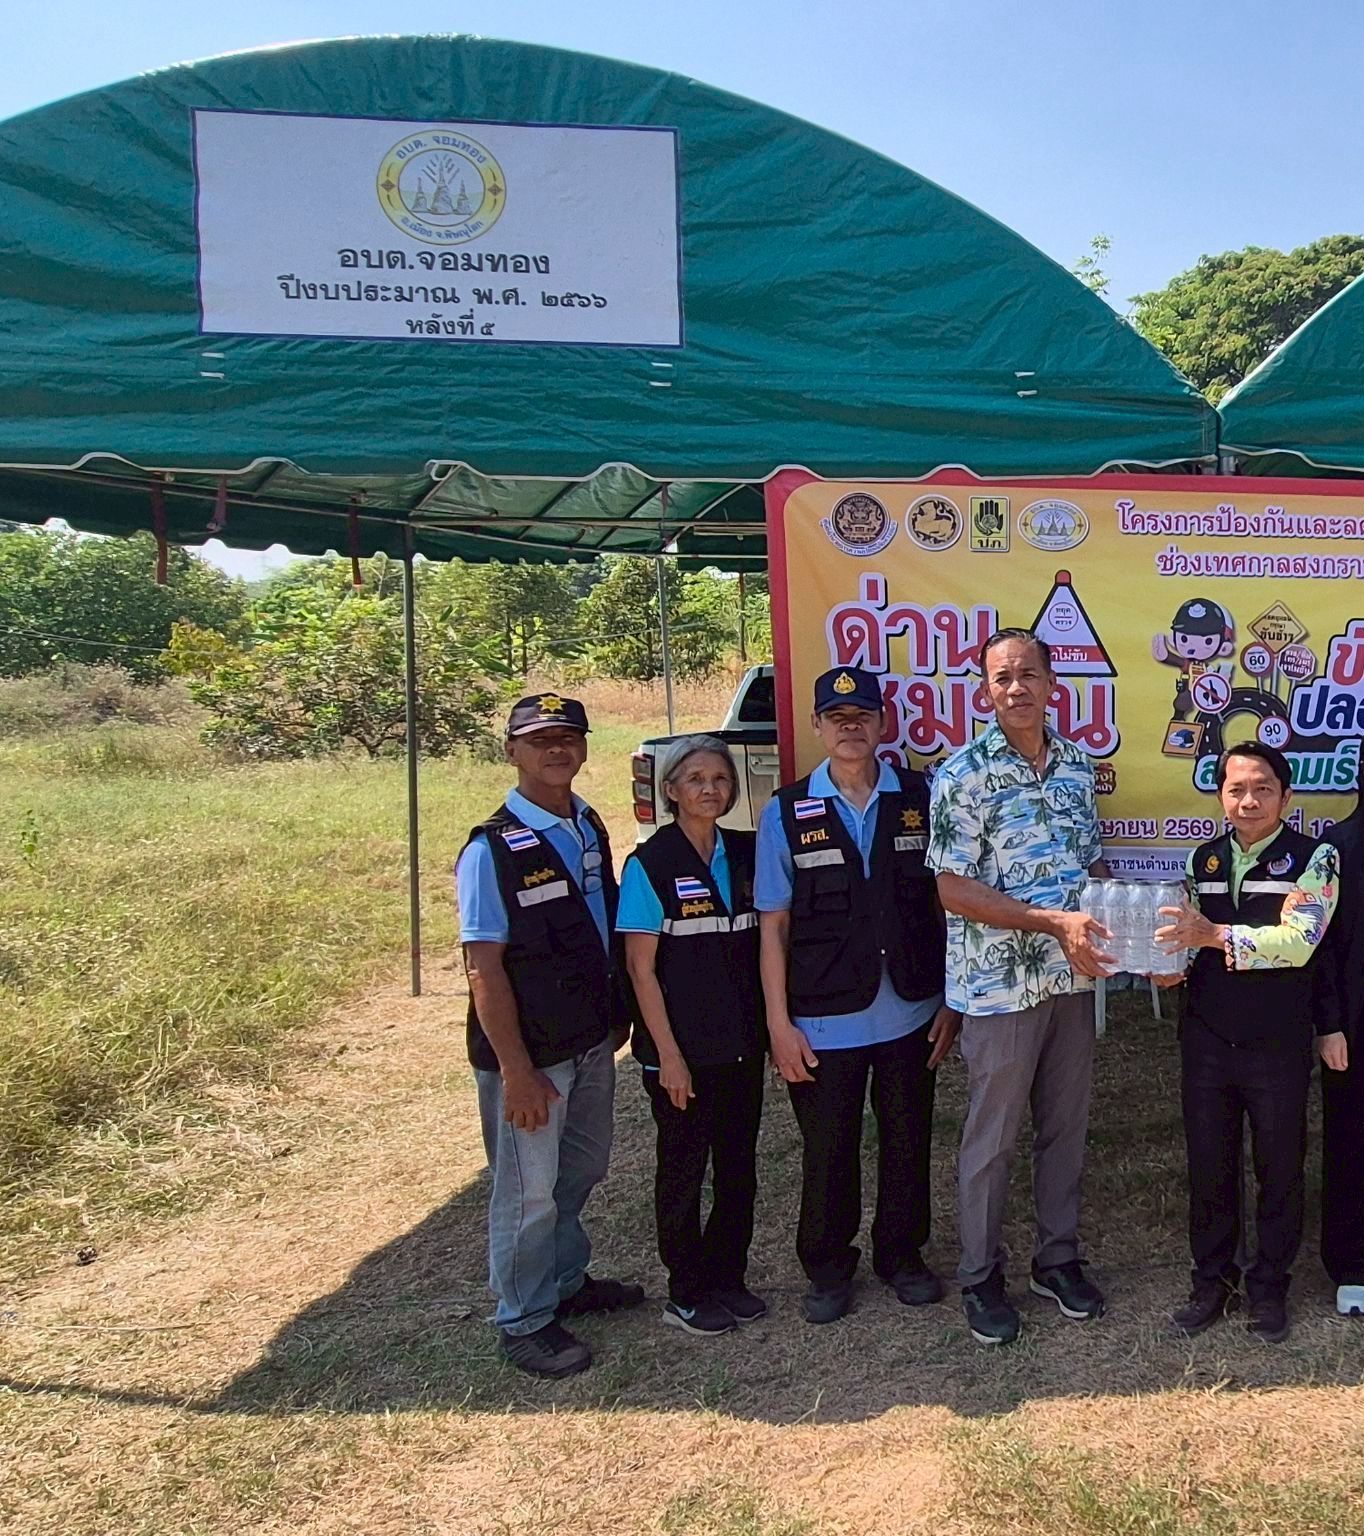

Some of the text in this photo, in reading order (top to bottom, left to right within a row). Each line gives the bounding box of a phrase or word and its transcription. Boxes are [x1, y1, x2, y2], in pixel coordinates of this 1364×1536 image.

[338, 246, 550, 275] อบต.จอมทอง
[277, 273, 608, 308] ปีงบประมาณ พ.ศ. ๒๕๖๖
[405, 309, 495, 337] หลังที่ ๕
[1051, 646, 1088, 661] าไม่ขับ
[1249, 655, 1265, 666] 60
[1264, 723, 1281, 737] 90
[1100, 819, 1156, 836] ษายน
[1165, 819, 1215, 836] 2569
